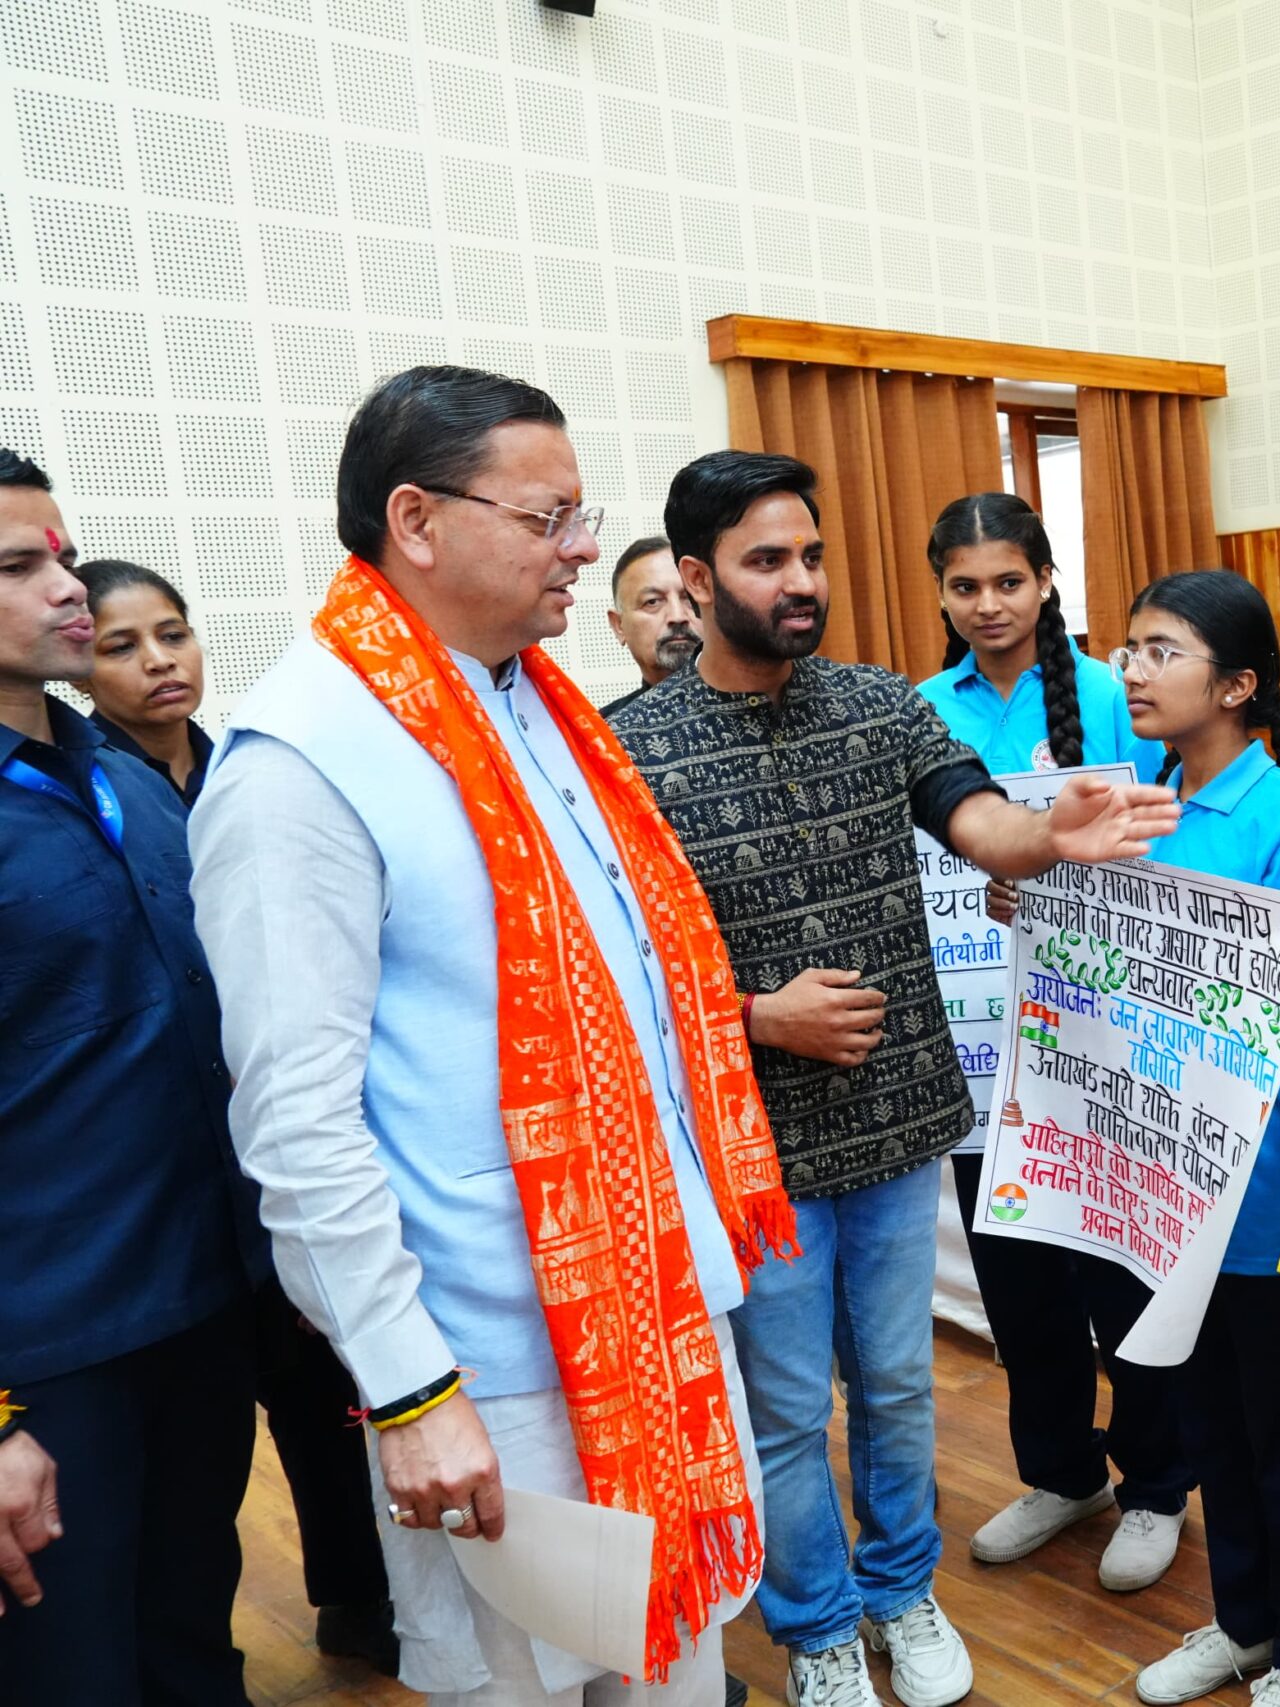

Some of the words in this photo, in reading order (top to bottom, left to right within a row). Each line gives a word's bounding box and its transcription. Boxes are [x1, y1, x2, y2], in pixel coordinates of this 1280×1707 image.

[1125, 956, 1197, 1011] धन्यवाद
[1110, 996, 1142, 1033] जन
[1143, 1009, 1207, 1061] जागरण
[1127, 1039, 1185, 1091] समिति
